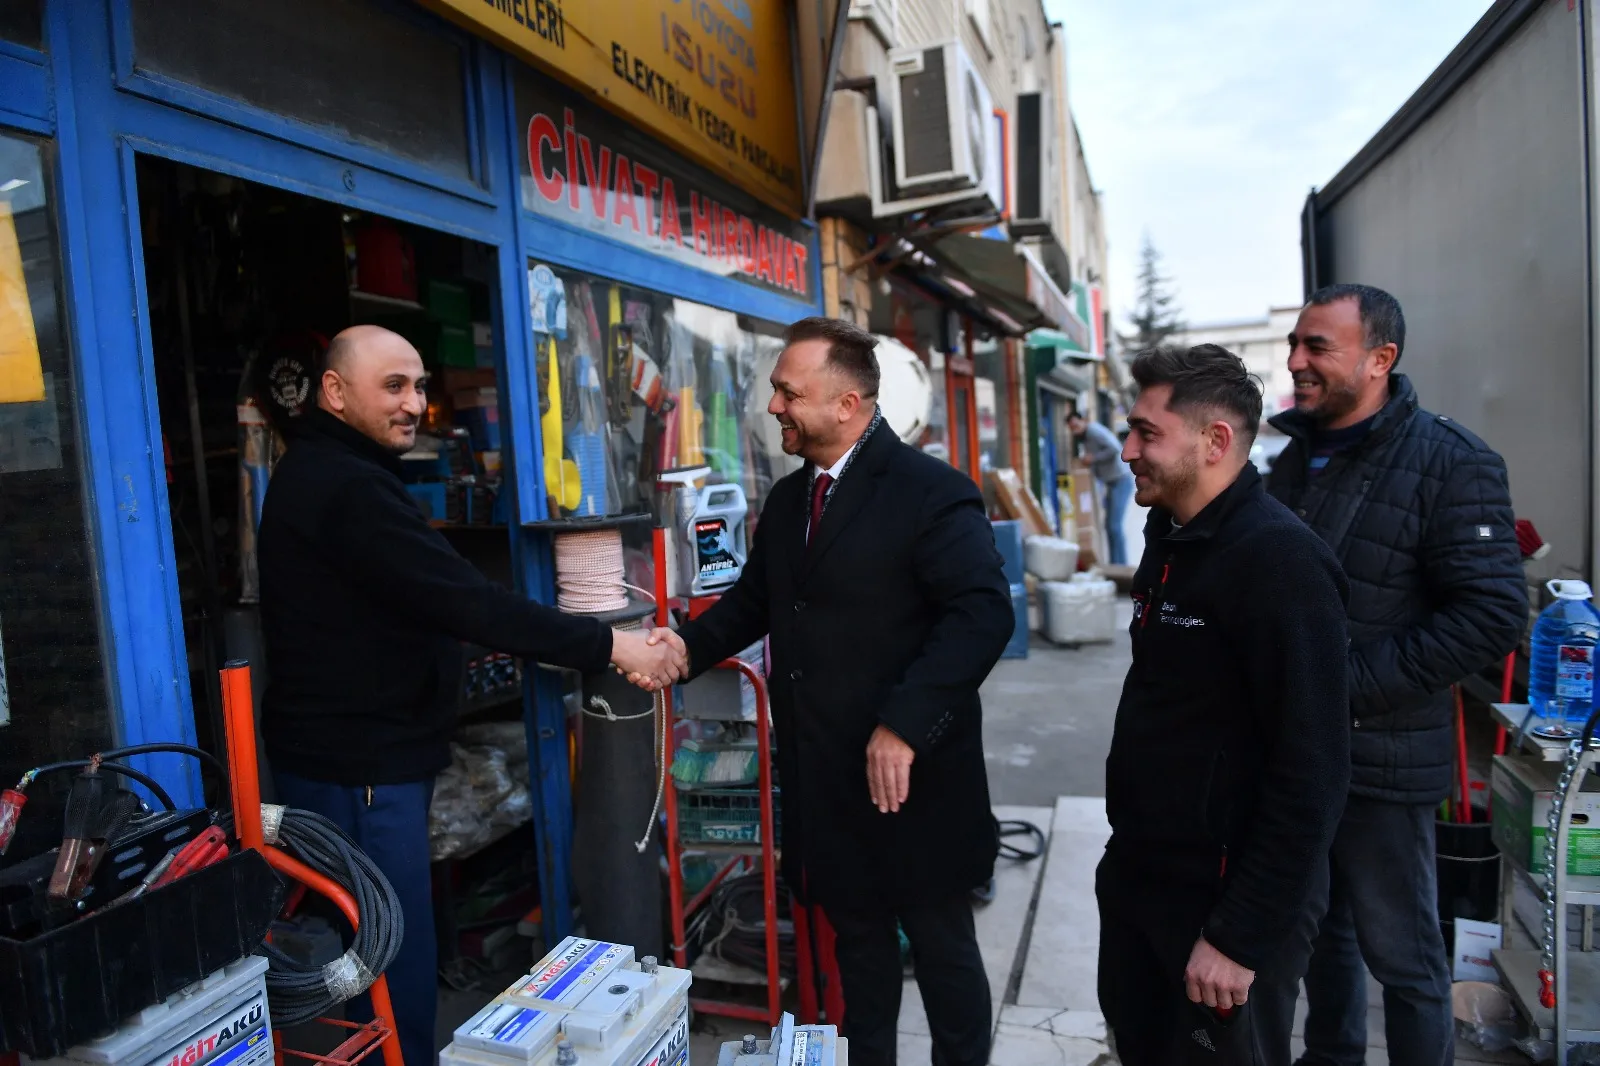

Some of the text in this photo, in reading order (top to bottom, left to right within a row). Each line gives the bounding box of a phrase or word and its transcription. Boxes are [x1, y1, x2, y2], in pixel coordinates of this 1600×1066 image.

[484, 0, 565, 49] ELERİ
[660, 11, 757, 119] ISUZU
[611, 40, 692, 124] ELEKTRİK
[694, 100, 738, 153] YEDEK
[527, 107, 808, 296] CİVATA HIRDAVAT
